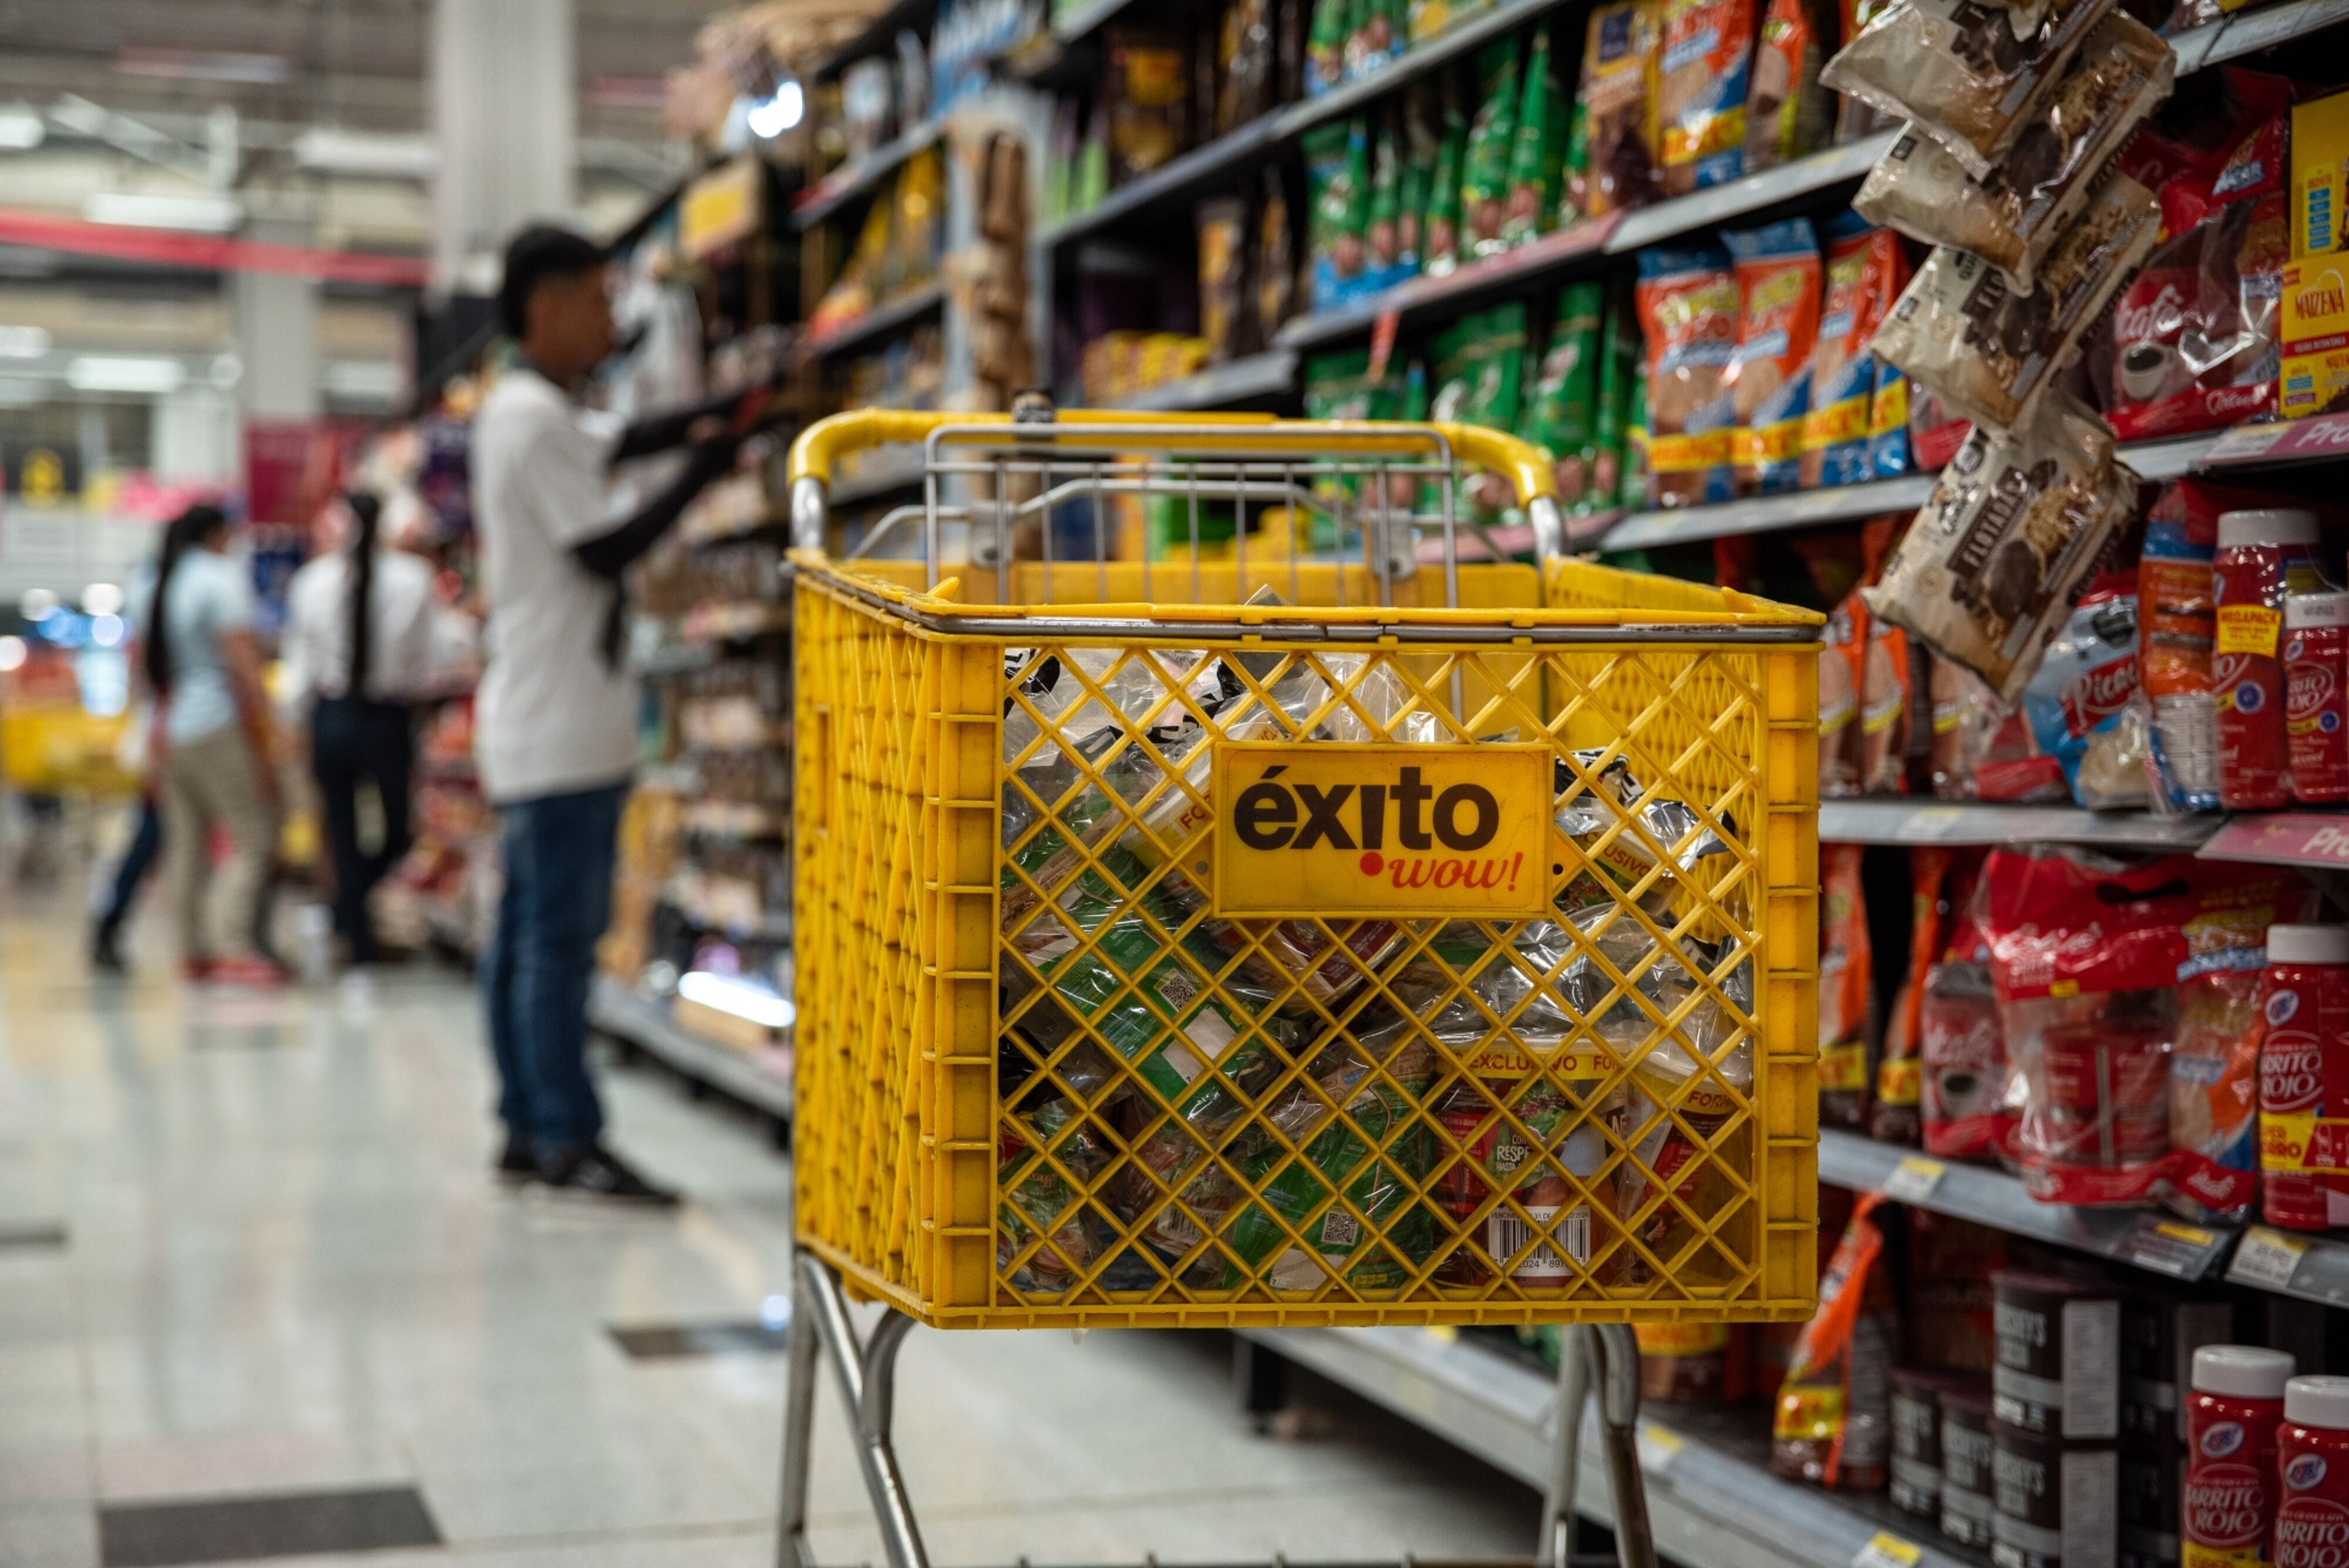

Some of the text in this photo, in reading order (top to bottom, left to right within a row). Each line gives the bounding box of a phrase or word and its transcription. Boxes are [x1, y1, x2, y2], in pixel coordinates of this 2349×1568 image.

[2295, 287, 2345, 321] MAIZENA
[1234, 765, 1499, 852] éxito
[1388, 852, 1523, 891] wow!
